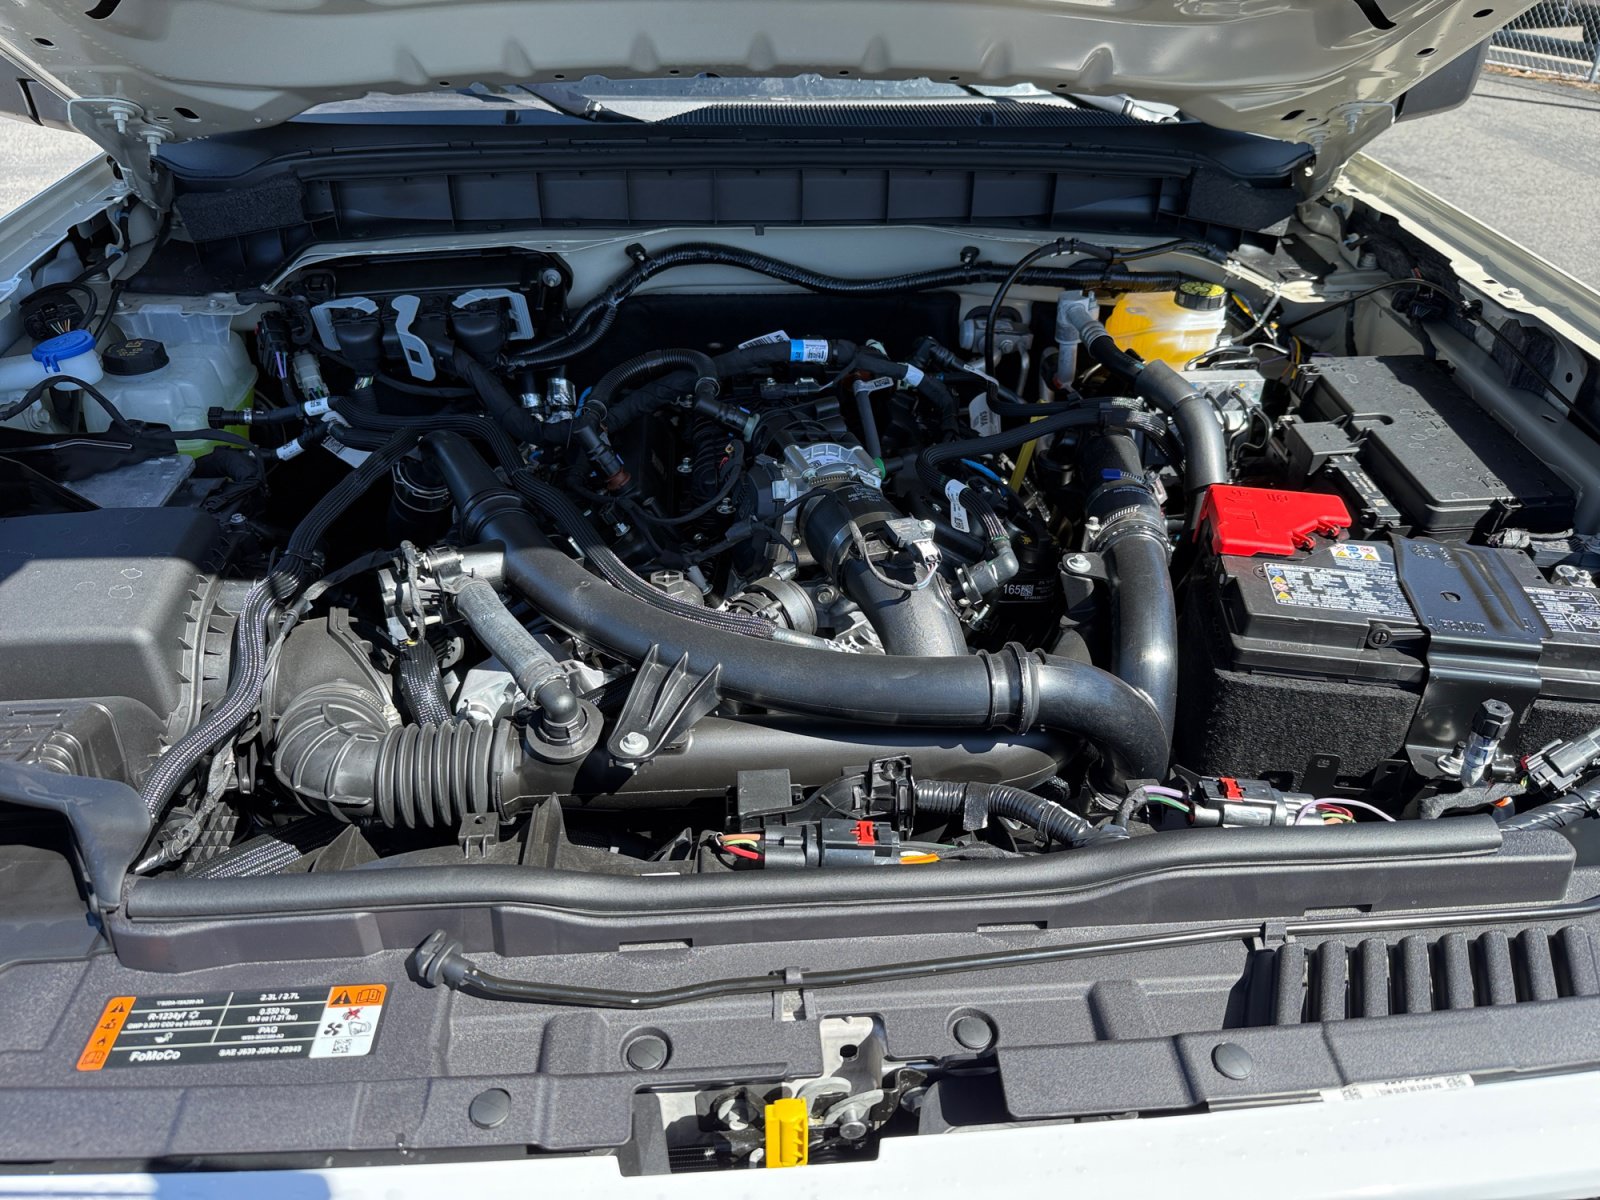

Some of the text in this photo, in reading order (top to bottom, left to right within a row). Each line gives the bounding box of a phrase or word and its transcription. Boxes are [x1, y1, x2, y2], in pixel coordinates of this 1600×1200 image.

[1003, 583, 1021, 595] 165
[260, 993, 277, 1001] 2.3L
[283, 992, 300, 1000] 2.7L
[280, 1007, 291, 1015] kg
[147, 1011, 187, 1021] R-1234yf
[257, 1026, 278, 1034] PAG
[129, 1049, 181, 1062] FoMoCo
[218, 1048, 237, 1057] SAE
